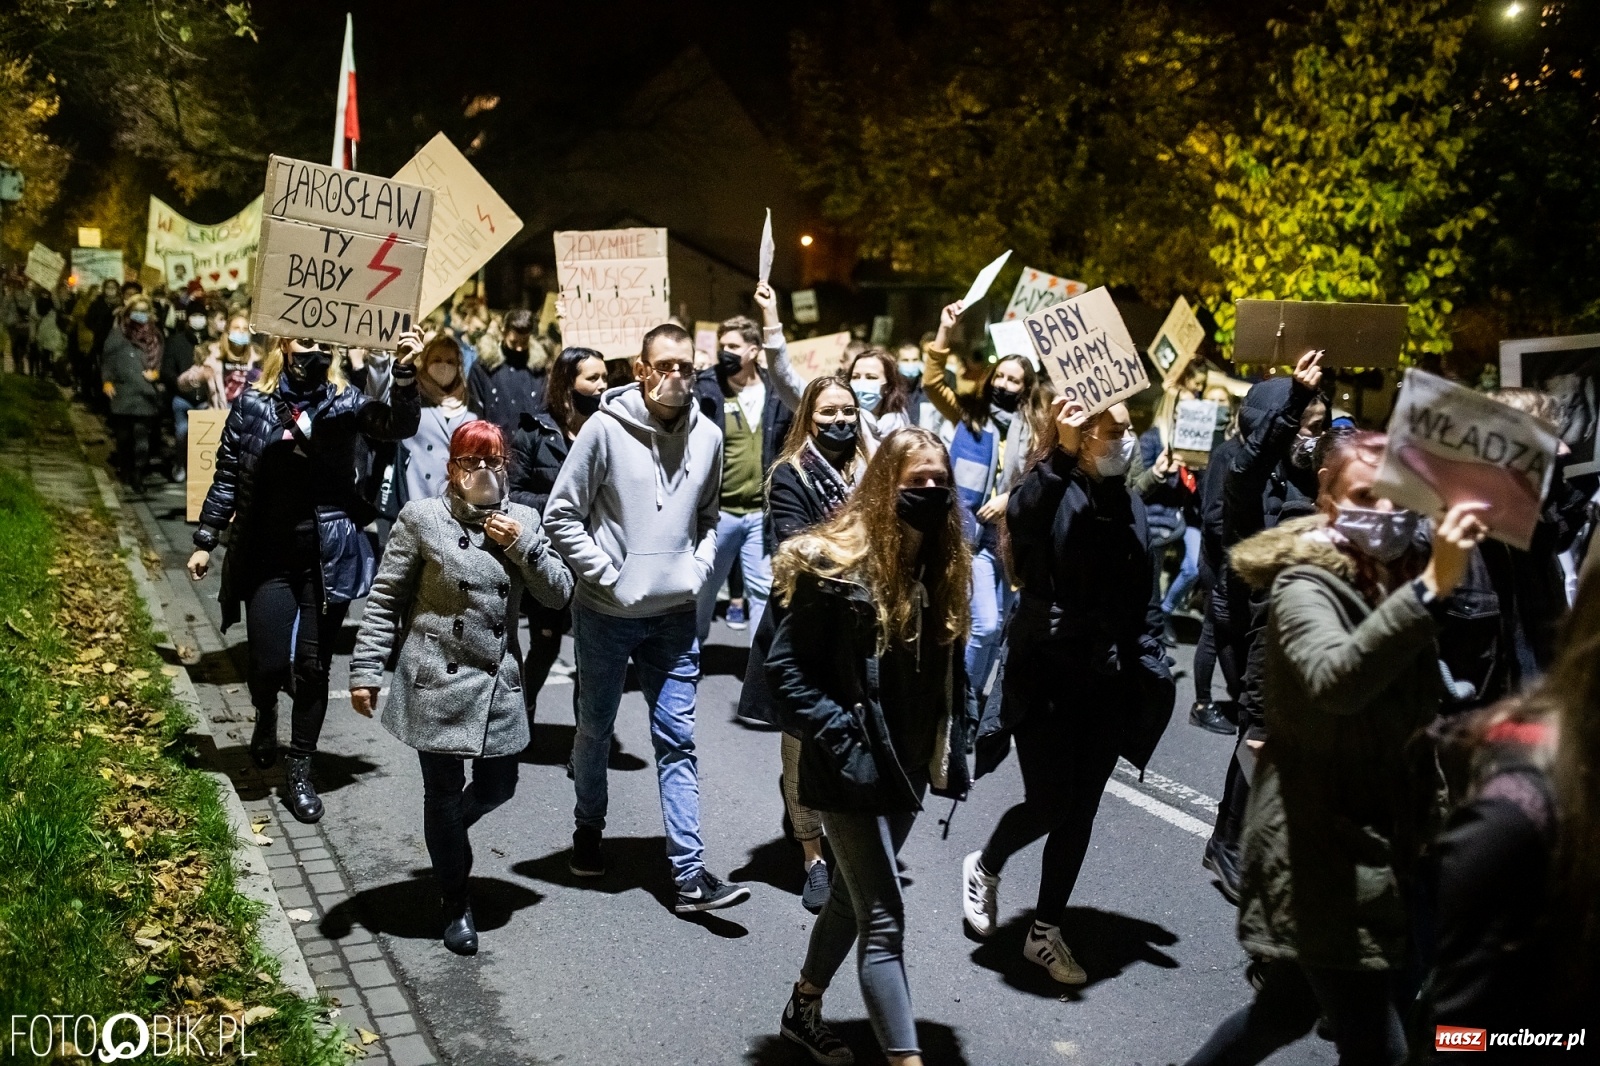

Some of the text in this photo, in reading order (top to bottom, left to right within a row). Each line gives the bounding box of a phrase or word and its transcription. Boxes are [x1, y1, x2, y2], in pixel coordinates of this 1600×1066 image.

[272, 161, 422, 230] JAROSŁAW
[319, 227, 354, 257] TY
[288, 253, 354, 291] BABY
[1028, 303, 1089, 355] BABY
[1056, 332, 1114, 380] MAMY
[1407, 402, 1545, 475] WŁADZA
